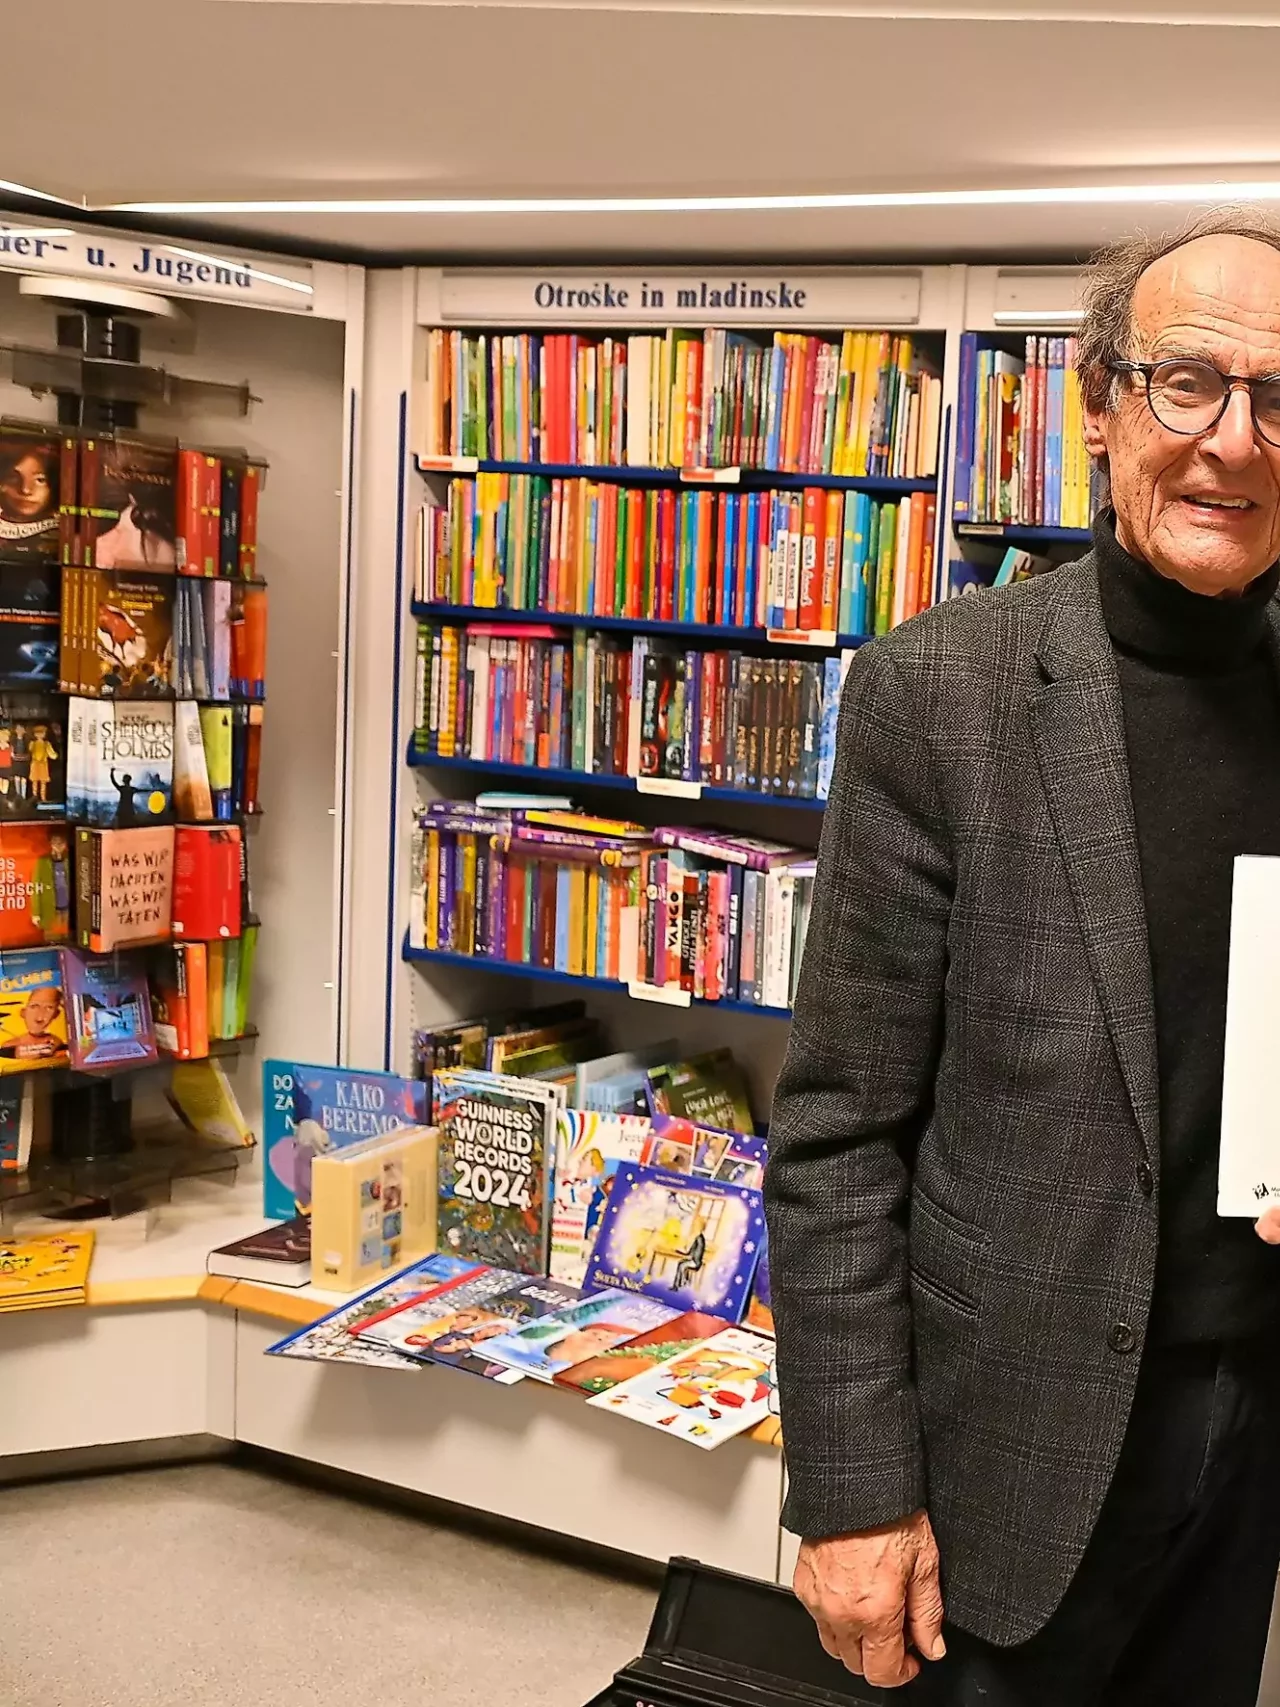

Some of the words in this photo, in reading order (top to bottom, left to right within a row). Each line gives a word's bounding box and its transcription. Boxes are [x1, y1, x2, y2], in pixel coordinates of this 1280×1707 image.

[133, 246, 251, 288] Jugend
[533, 281, 629, 310] Otroške
[641, 282, 664, 308] in
[676, 281, 808, 309] mladinske
[101, 738, 172, 761] HOLMES
[110, 852, 140, 868] WAS
[109, 891, 140, 909] WAS
[335, 1080, 385, 1110] KAKO
[322, 1107, 400, 1137] BEREMO
[456, 1098, 533, 1132] GUINNESS
[454, 1116, 533, 1155] WORLD
[454, 1143, 533, 1175] RECORDS
[454, 1160, 533, 1212] 2024
